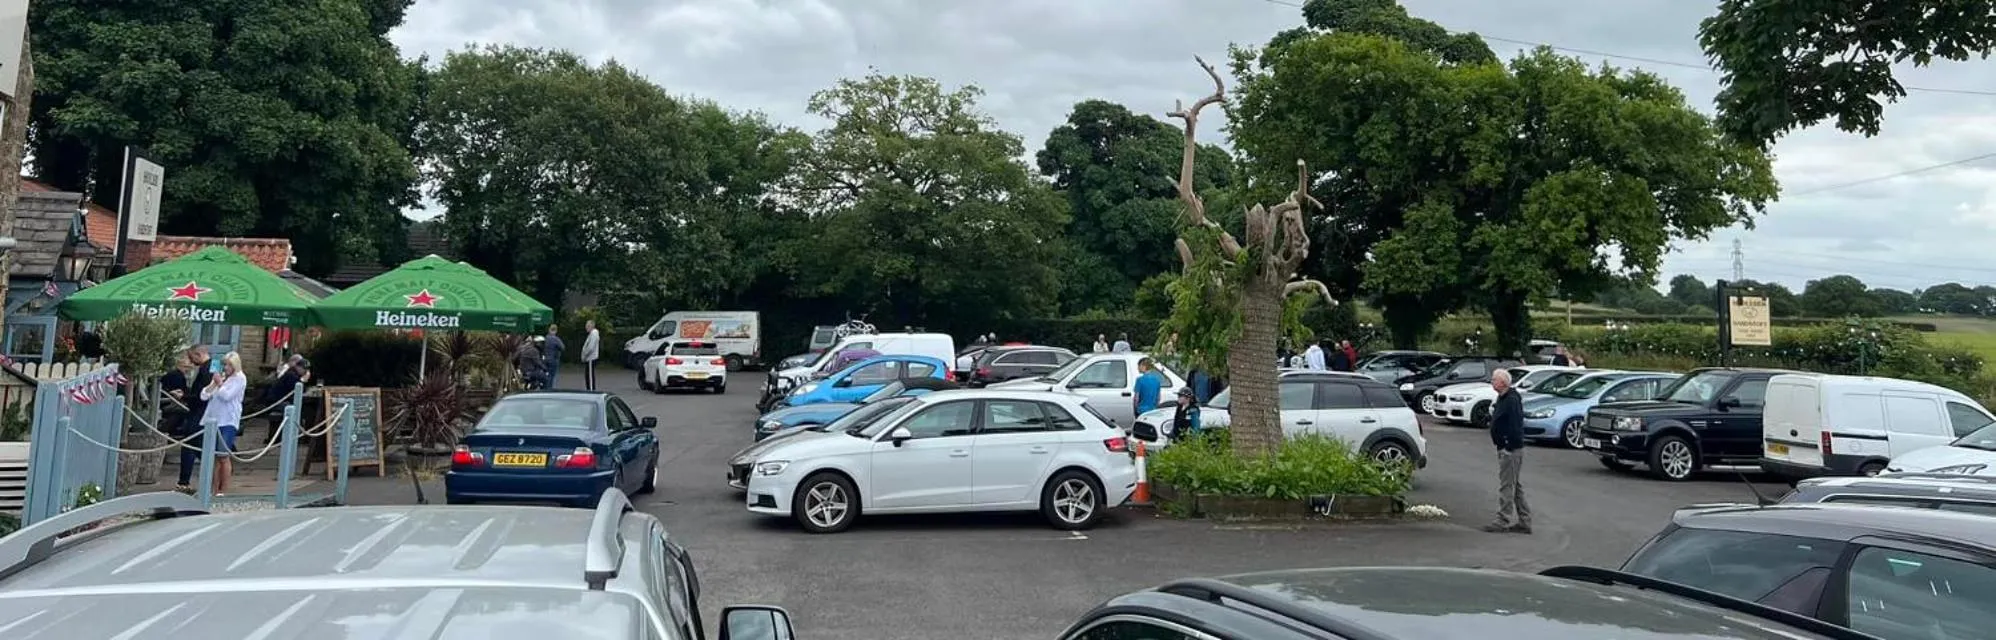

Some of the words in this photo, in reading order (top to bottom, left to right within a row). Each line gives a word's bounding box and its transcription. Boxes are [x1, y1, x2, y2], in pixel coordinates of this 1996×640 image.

[132, 302, 226, 322] Heineken
[375, 310, 460, 328] Heineken
[497, 454, 517, 464] GEZ
[518, 454, 543, 464] 8720
